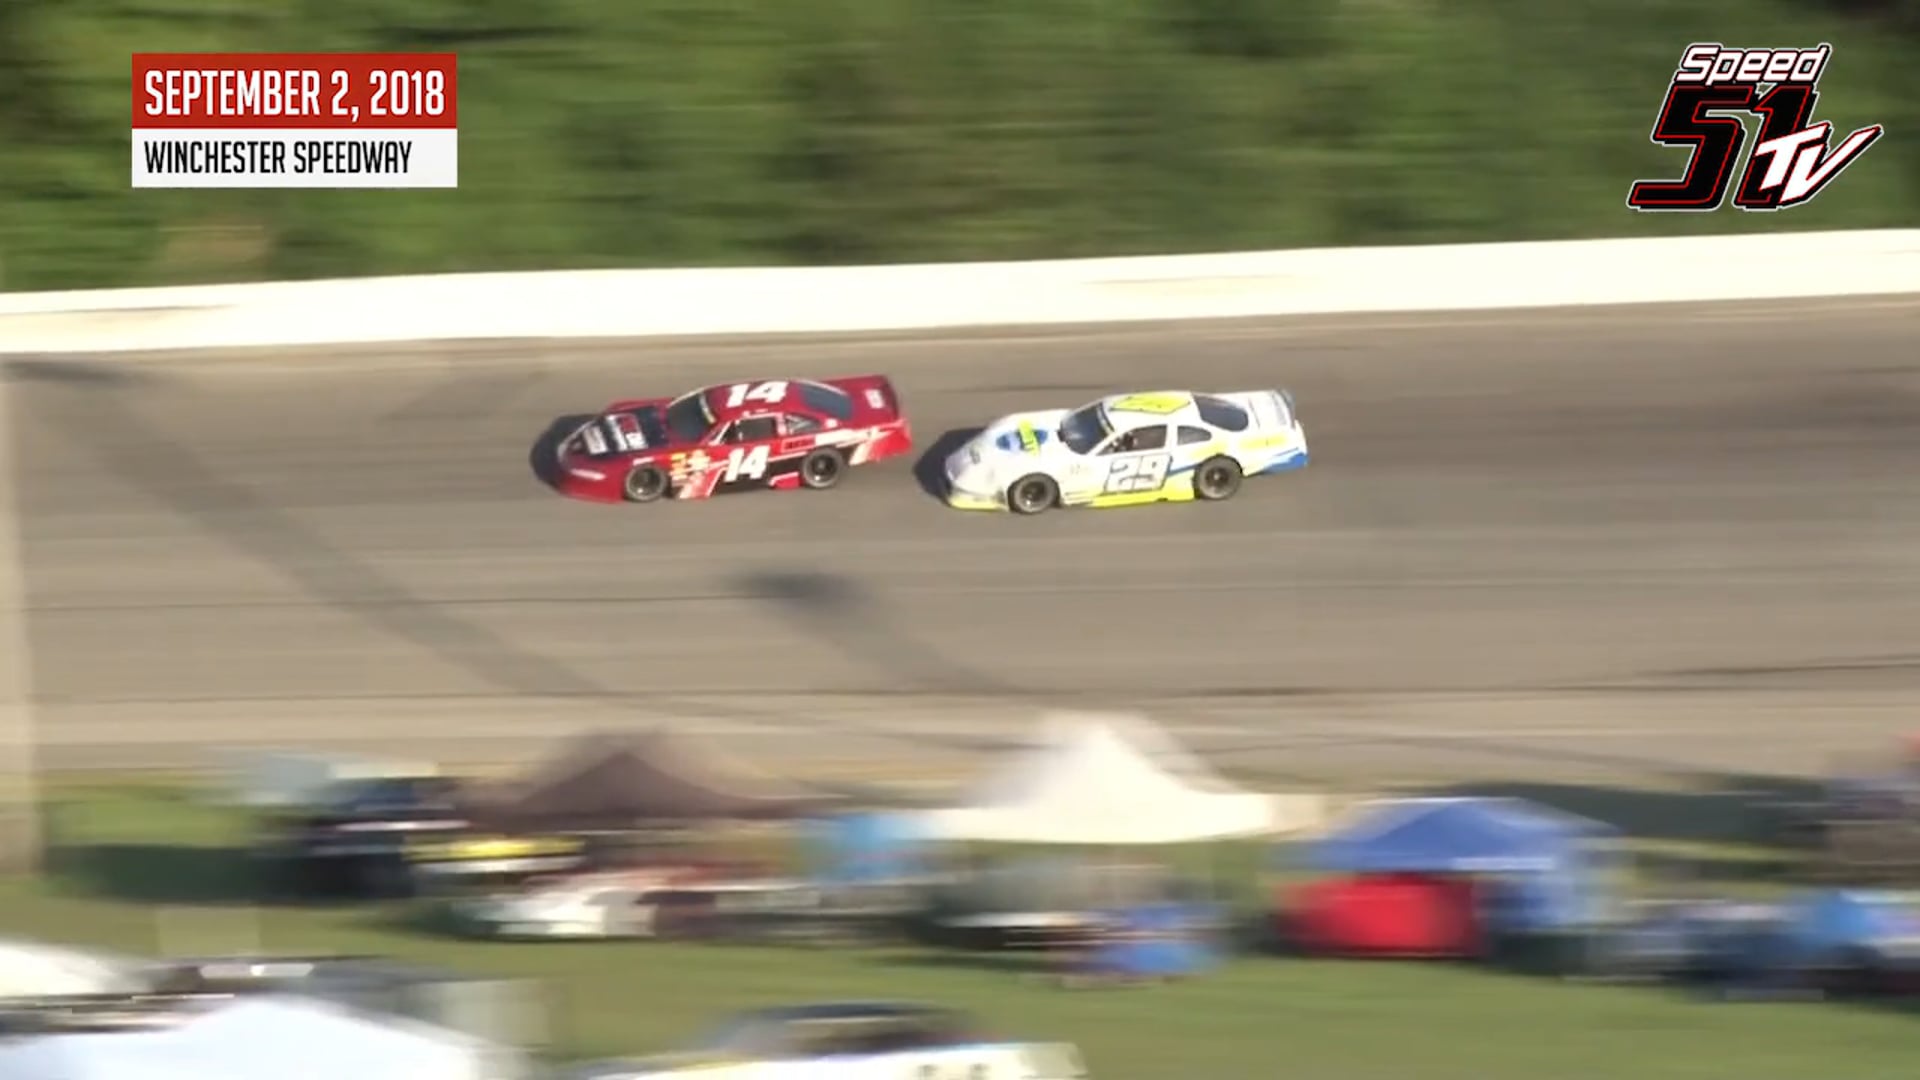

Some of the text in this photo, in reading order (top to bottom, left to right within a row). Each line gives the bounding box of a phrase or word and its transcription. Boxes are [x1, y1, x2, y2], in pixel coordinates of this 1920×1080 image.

[727, 382, 788, 407] 14
[724, 446, 770, 482] 14
[1104, 455, 1171, 492] 29
